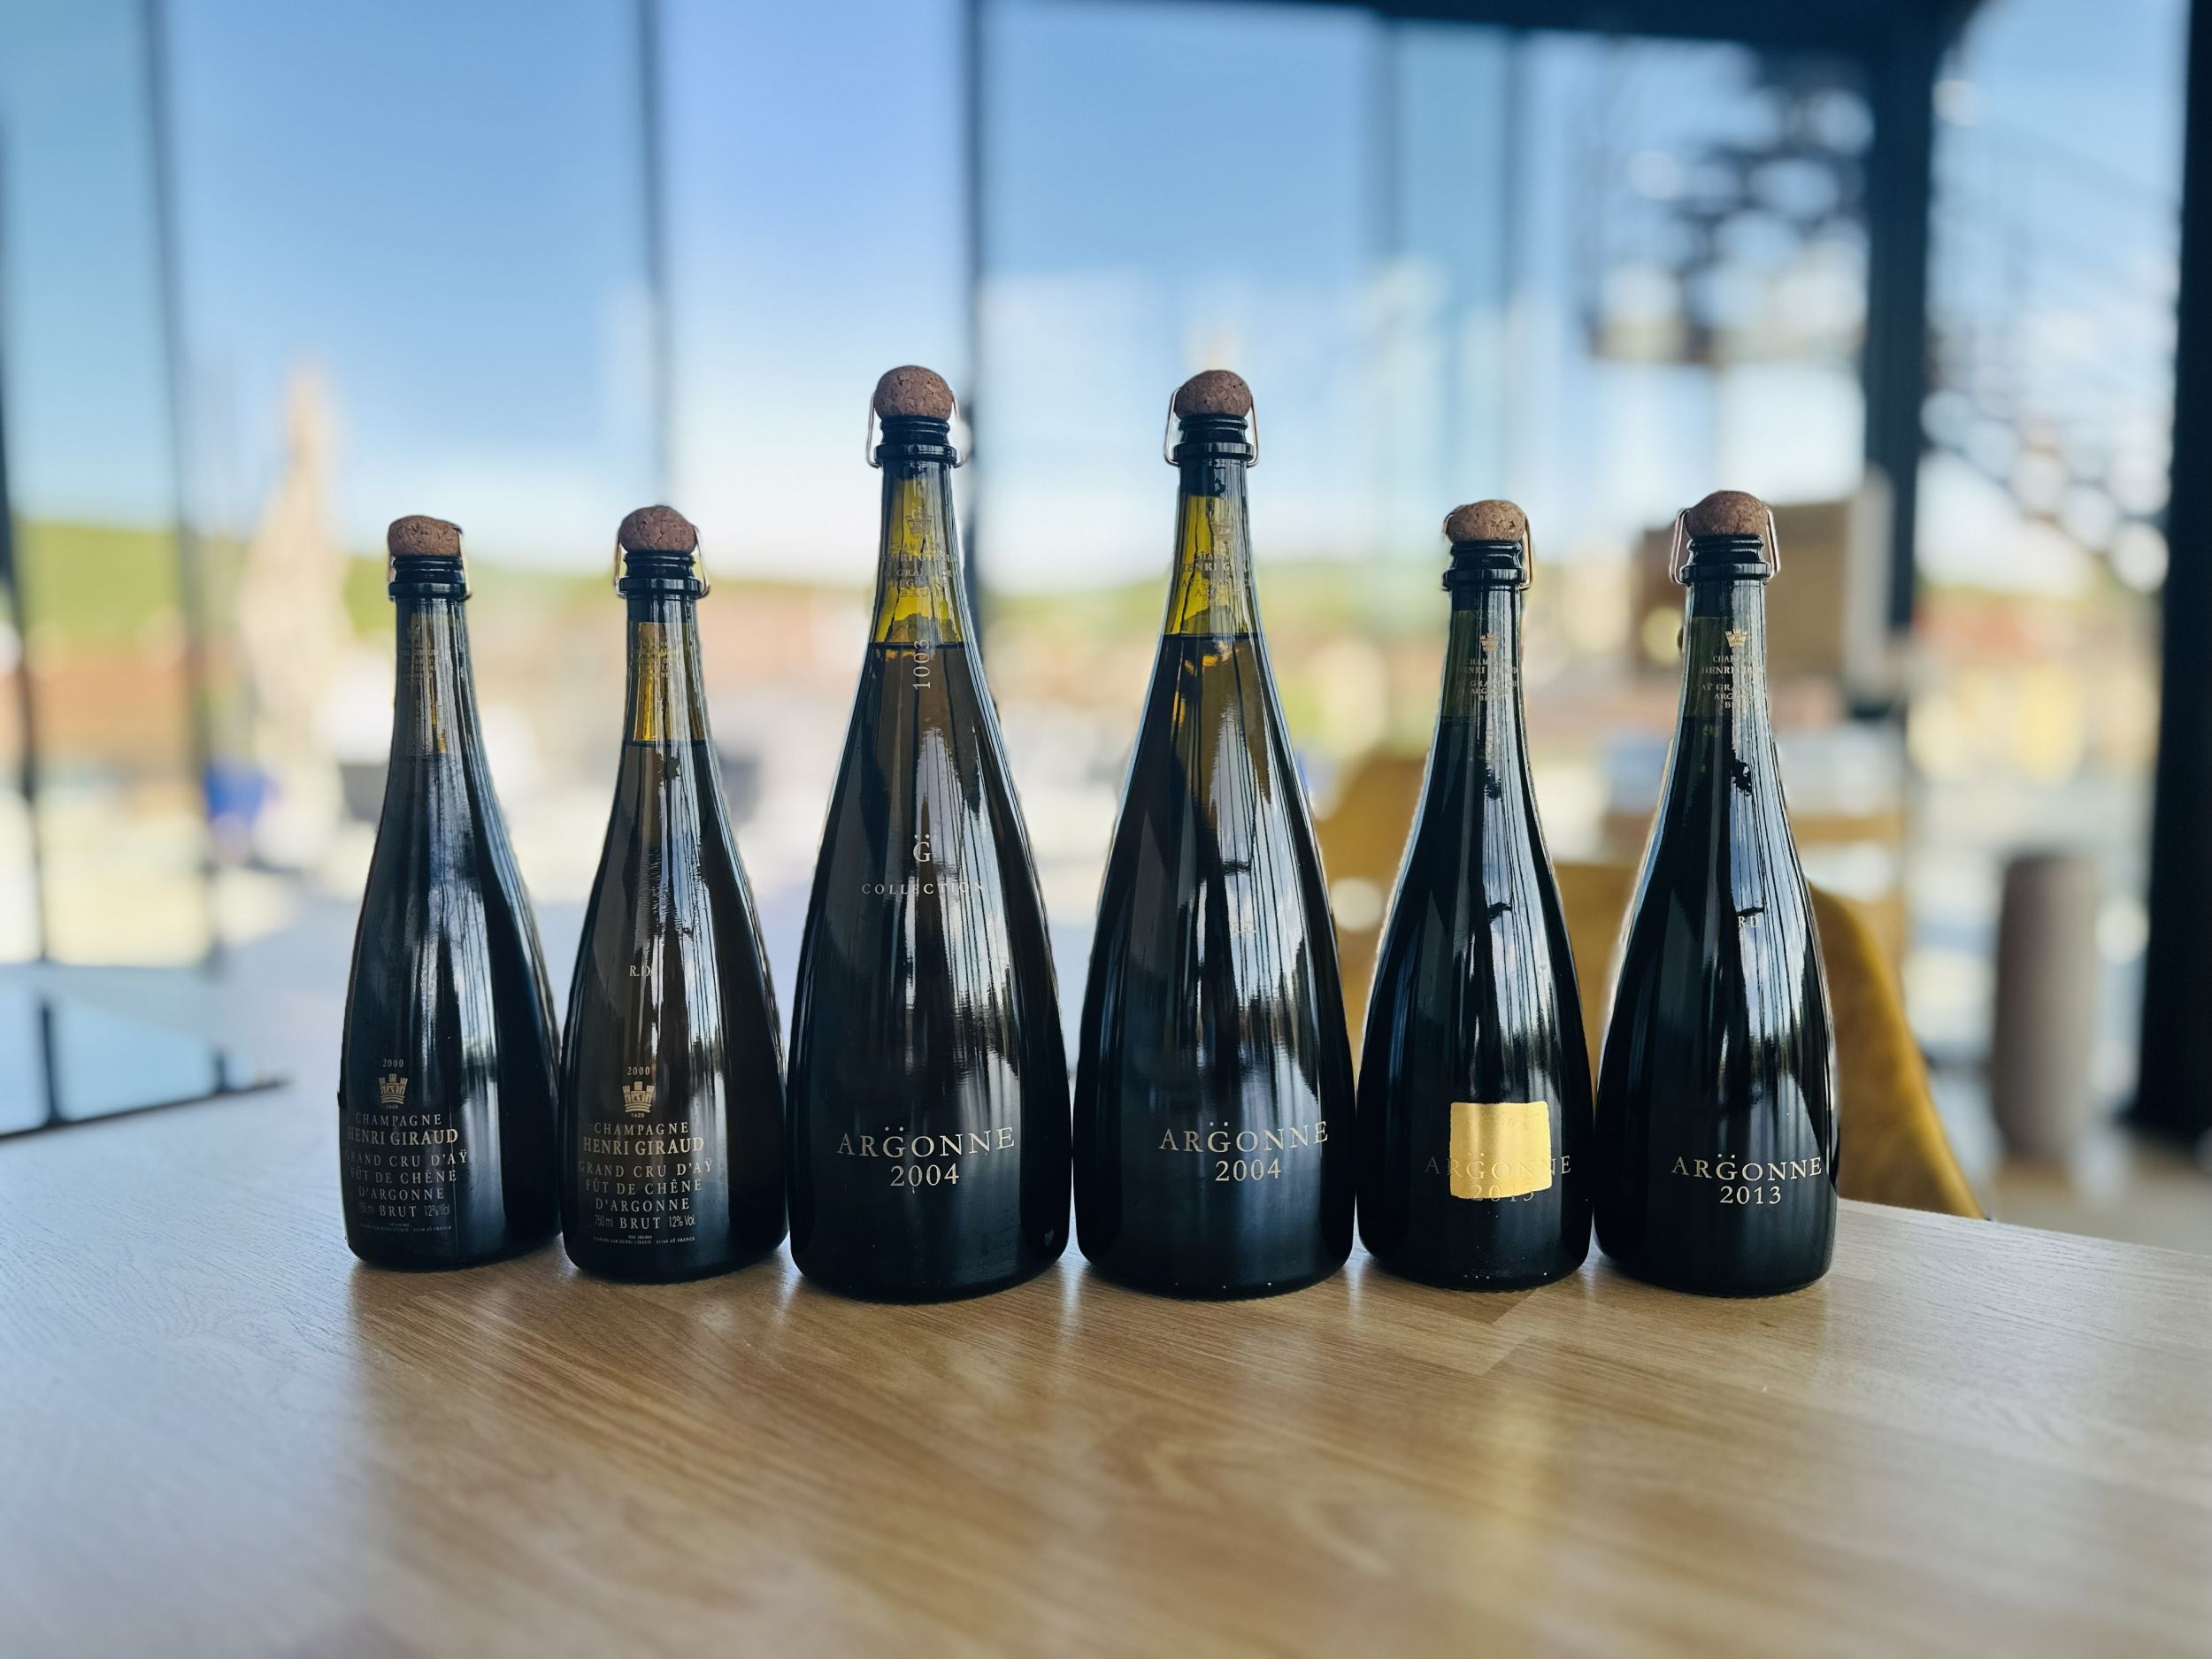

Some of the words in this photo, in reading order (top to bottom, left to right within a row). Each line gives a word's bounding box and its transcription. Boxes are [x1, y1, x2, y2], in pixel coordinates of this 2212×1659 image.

[912, 639, 931, 690] 1003
[862, 882, 985, 895] COLLECTION
[382, 1058, 404, 1068] 2000
[626, 1066, 650, 1076] 2000
[355, 1113, 442, 1127] CHAMPAGNE
[347, 1126, 385, 1145] HENRI
[390, 1128, 459, 1146] GIRAUD
[595, 1121, 688, 1136] CHAMPAGNE
[583, 1137, 630, 1156] HENRI
[634, 1137, 704, 1156] GIRAUD
[344, 1148, 382, 1166] GRAND
[389, 1154, 421, 1168] CRU
[375, 1171, 392, 1184] DE
[579, 1161, 625, 1178] GRAND
[634, 1164, 667, 1179] CRU
[890, 1162, 960, 1187] 2004
[1215, 1159, 1282, 1182] 2004
[358, 1186, 444, 1201] D'ARGONNE
[585, 1178, 610, 1194] FÛT
[617, 1183, 636, 1195] DE
[644, 1178, 703, 1195] CHÊNE
[1719, 1186, 1782, 1206] 2013
[380, 1204, 417, 1217] BRUT
[595, 1197, 690, 1212] D'ARGONNE
[619, 1217, 661, 1230] BRUT
